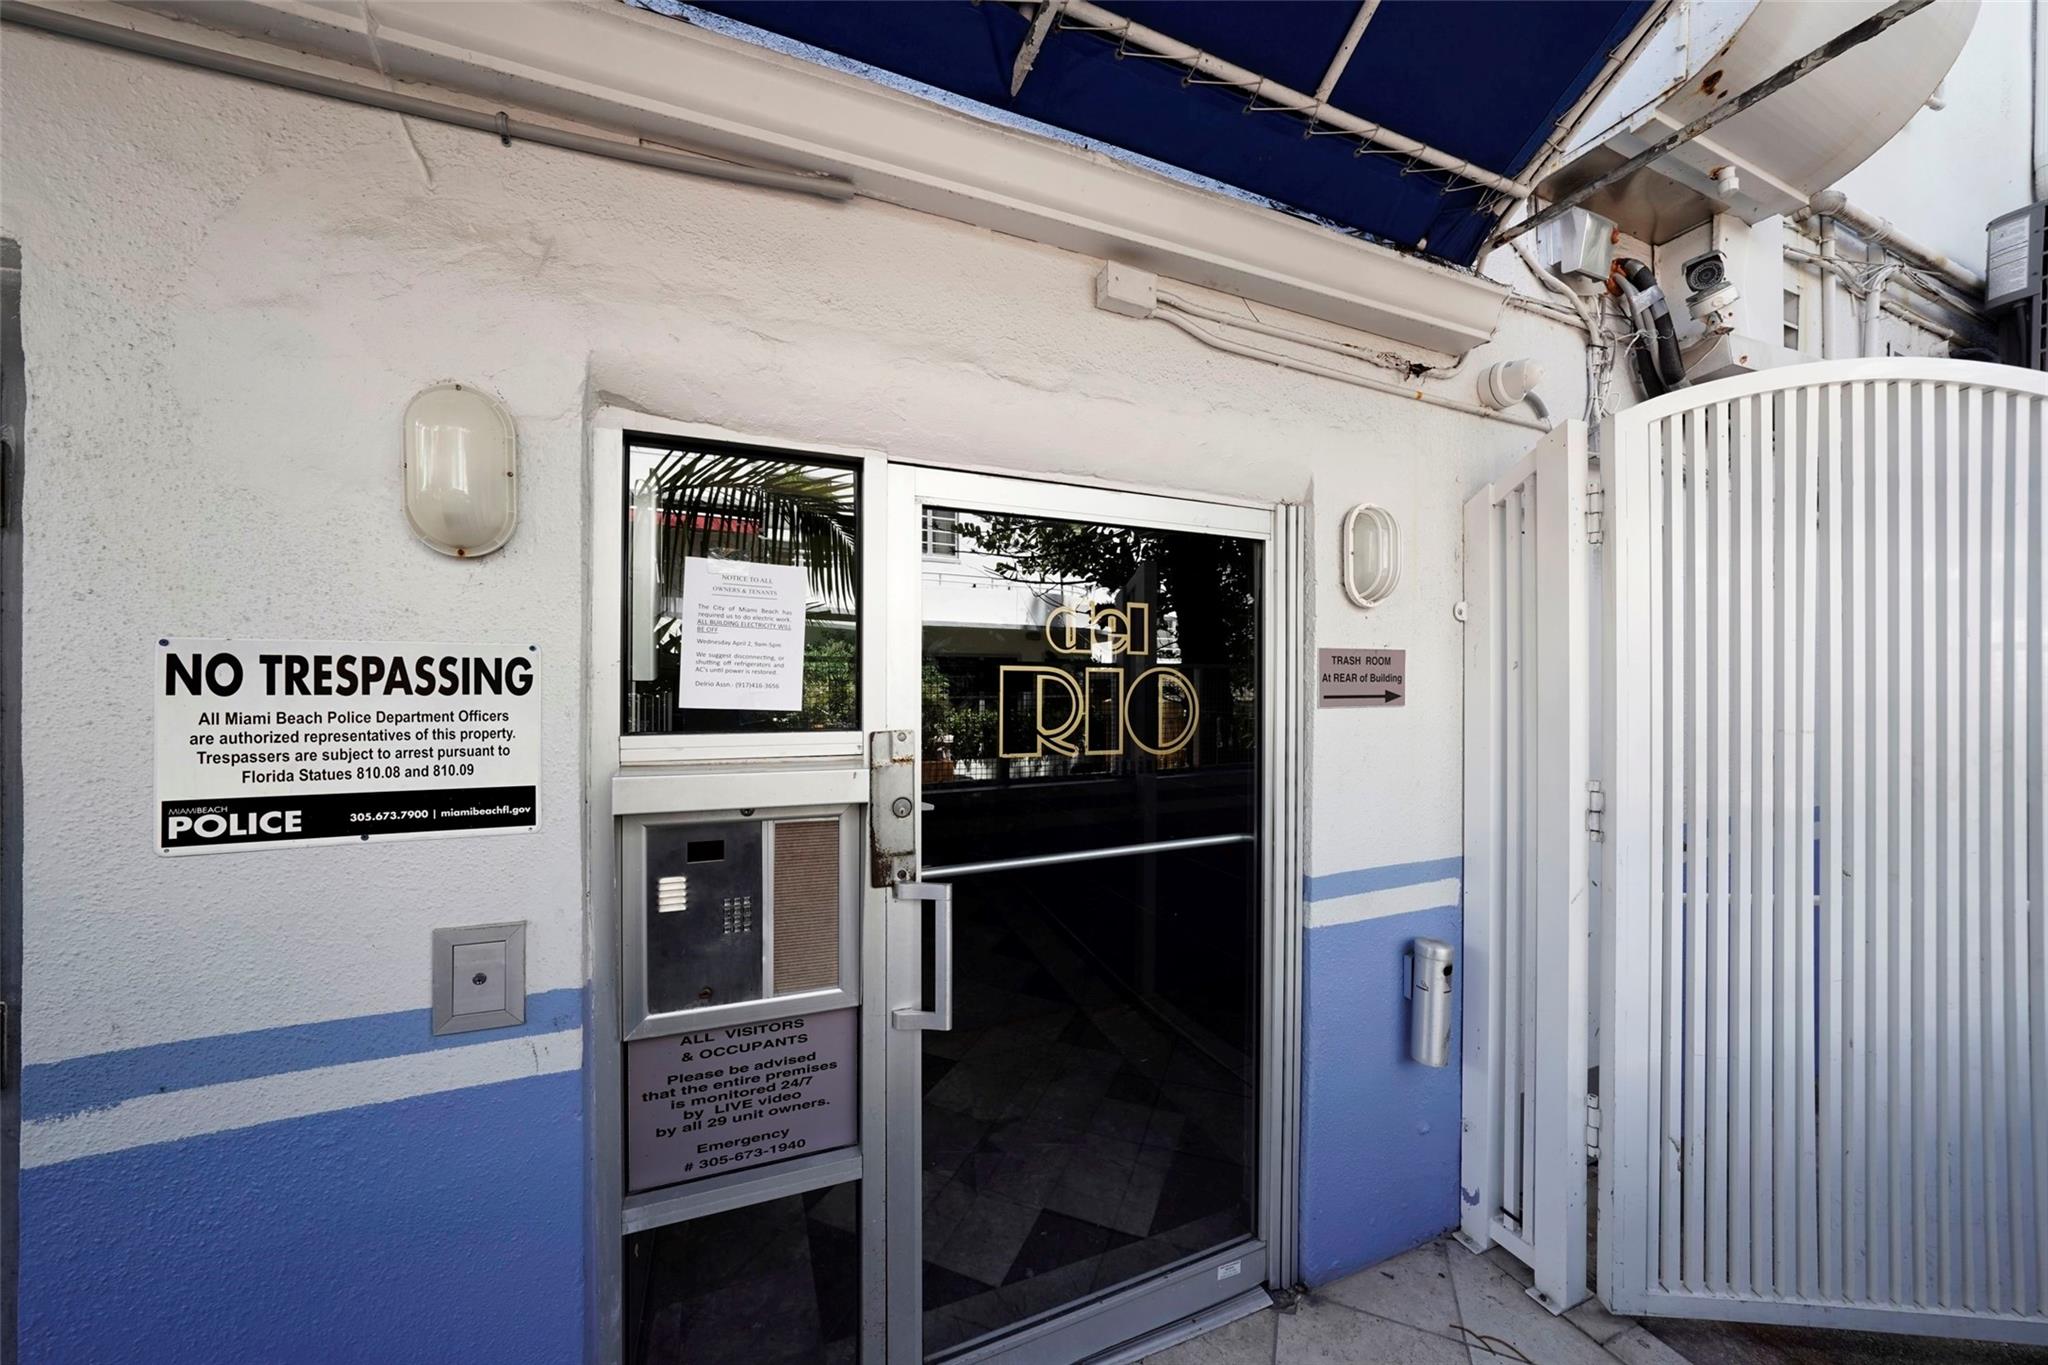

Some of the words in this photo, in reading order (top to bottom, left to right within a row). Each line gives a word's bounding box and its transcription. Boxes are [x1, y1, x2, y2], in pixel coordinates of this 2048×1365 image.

[722, 574, 747, 582] NOTICE
[698, 612, 724, 620] required
[1046, 601, 1148, 655] del
[1331, 656, 1360, 665] TRASH
[1366, 657, 1391, 665] ROOM
[165, 652, 244, 697] NO
[259, 653, 534, 697] TRESPASSING
[1322, 674, 1331, 682] At
[1333, 674, 1357, 682] REAR
[1360, 674, 1367, 682] of
[1370, 674, 1402, 684] Building
[198, 711, 220, 726] All
[225, 711, 271, 726] Miami
[275, 711, 322, 725] Beach
[328, 710, 372, 724] Police
[376, 711, 454, 727] Department
[459, 709, 509, 723] Officers
[999, 665, 1199, 758] RIO
[189, 733, 215, 745] are
[219, 730, 299, 745] authorized
[303, 729, 411, 746] representatives
[415, 728, 429, 742] of
[432, 728, 456, 741] this
[460, 728, 516, 743] property.
[197, 750, 290, 767] Trespassers
[295, 751, 318, 762] are
[322, 747, 374, 764] subject
[378, 748, 391, 760] to
[395, 746, 433, 760] arrest
[437, 746, 495, 761] pursuant
[498, 744, 510, 757] to
[242, 769, 294, 783] Florida
[299, 768, 352, 781] Statues
[357, 766, 400, 779] 810.08
[404, 765, 429, 778] and
[433, 764, 474, 777] 810.09
[168, 806, 228, 816] MIAMIBEACH
[350, 808, 429, 822] 305.673.7900
[441, 805, 531, 819] miamibeachfl.gov
[168, 810, 302, 840] POLICE
[680, 1034, 715, 1046] ALL
[725, 1019, 805, 1039] VISITORS
[682, 1053, 694, 1062] &
[700, 1034, 808, 1059] OCCUPANTS
[642, 1089, 675, 1102] that
[682, 1084, 708, 1095] the
[713, 1074, 760, 1091] entire
[766, 1061, 837, 1082] premises
[667, 1068, 724, 1085] Please
[729, 1064, 749, 1075] be
[754, 1052, 816, 1071] advised
[671, 1100, 685, 1110] is
[691, 1084, 776, 1107] monitored
[781, 1076, 813, 1090] 24/7
[684, 1109, 704, 1120] by
[715, 1100, 753, 1114] LIVE
[758, 1091, 802, 1106] video
[656, 1126, 677, 1138] by
[682, 1121, 701, 1132] all
[708, 1117, 727, 1128] 29
[732, 1109, 764, 1123] unit
[768, 1098, 830, 1116] owners.
[697, 1128, 790, 1154] Emergency
[685, 1163, 694, 1172] #
[699, 1139, 806, 1169] 305-673-1940
